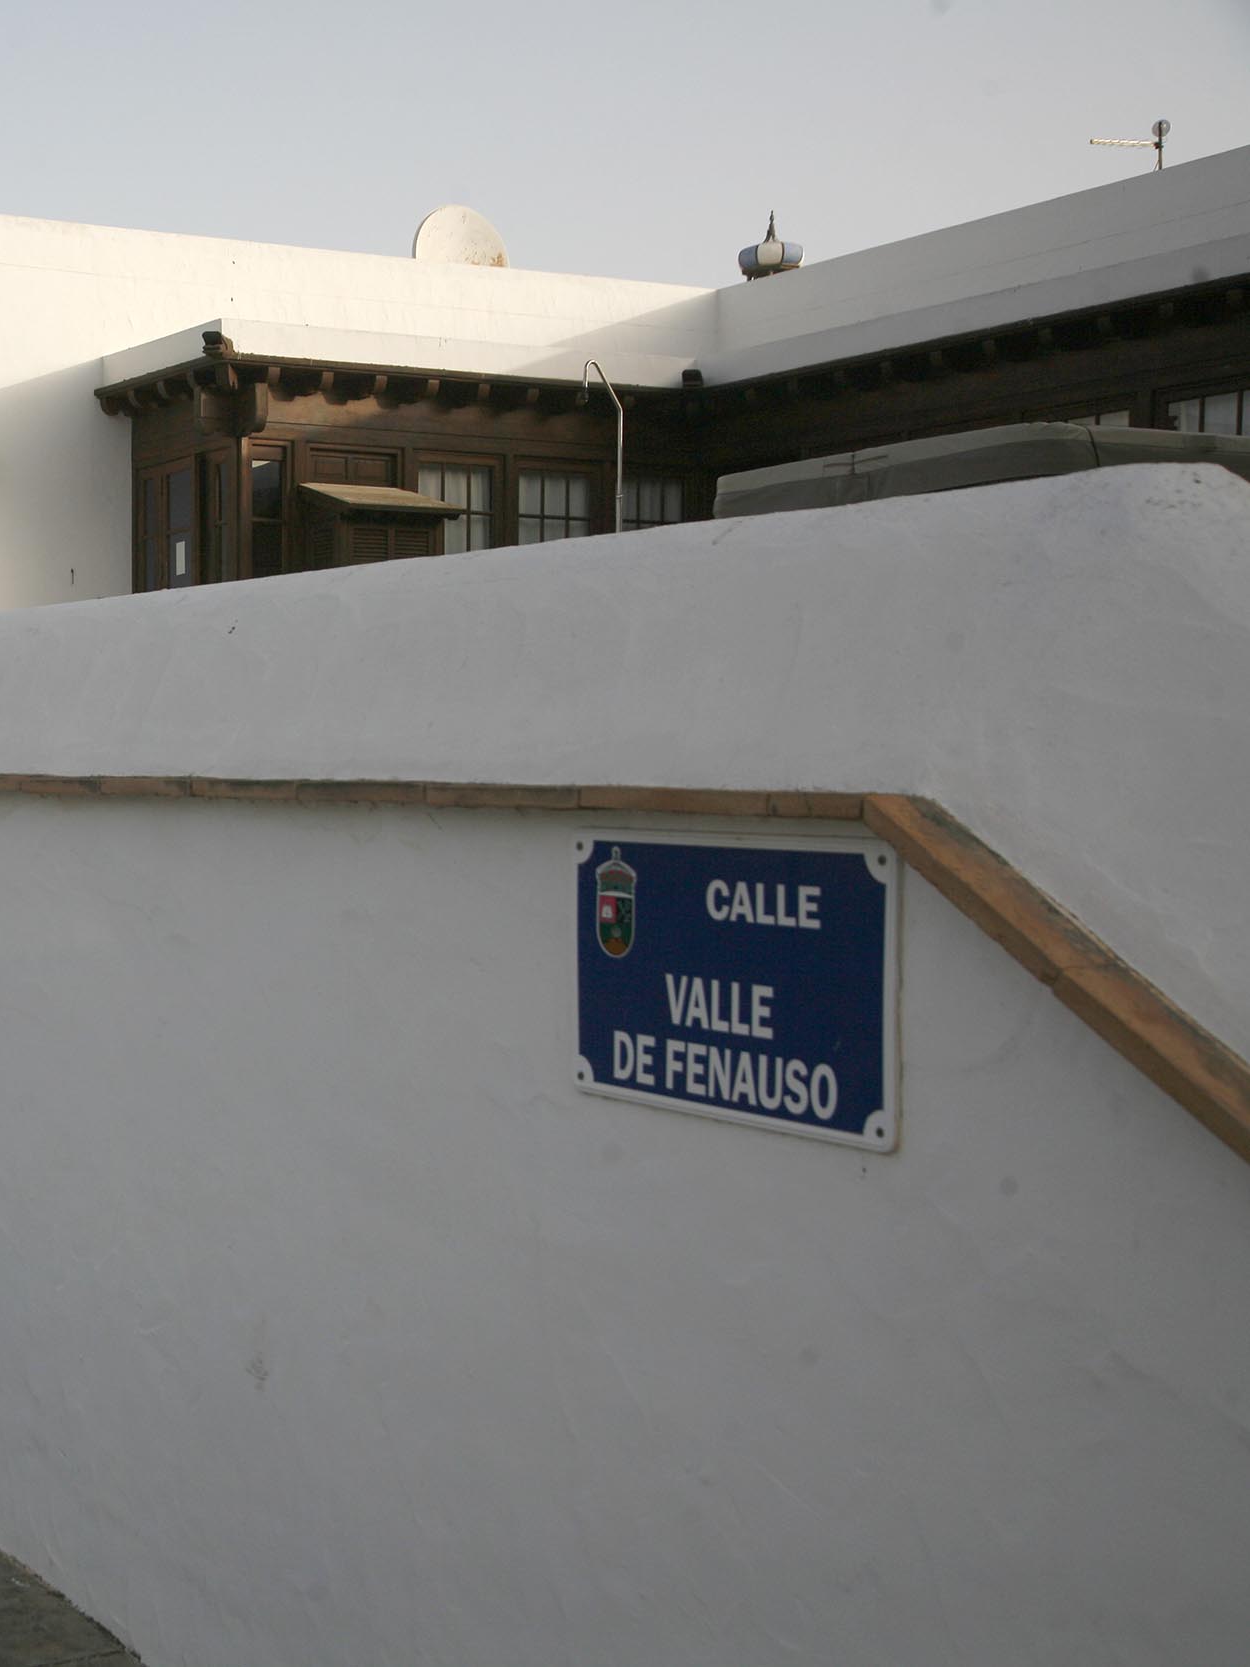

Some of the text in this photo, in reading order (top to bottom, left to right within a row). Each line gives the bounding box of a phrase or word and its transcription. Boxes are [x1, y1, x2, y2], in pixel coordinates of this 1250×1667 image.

[706, 879, 821, 929] CALLE
[665, 973, 774, 1040] VALLE
[613, 1030, 838, 1120] DE FENAUSO
